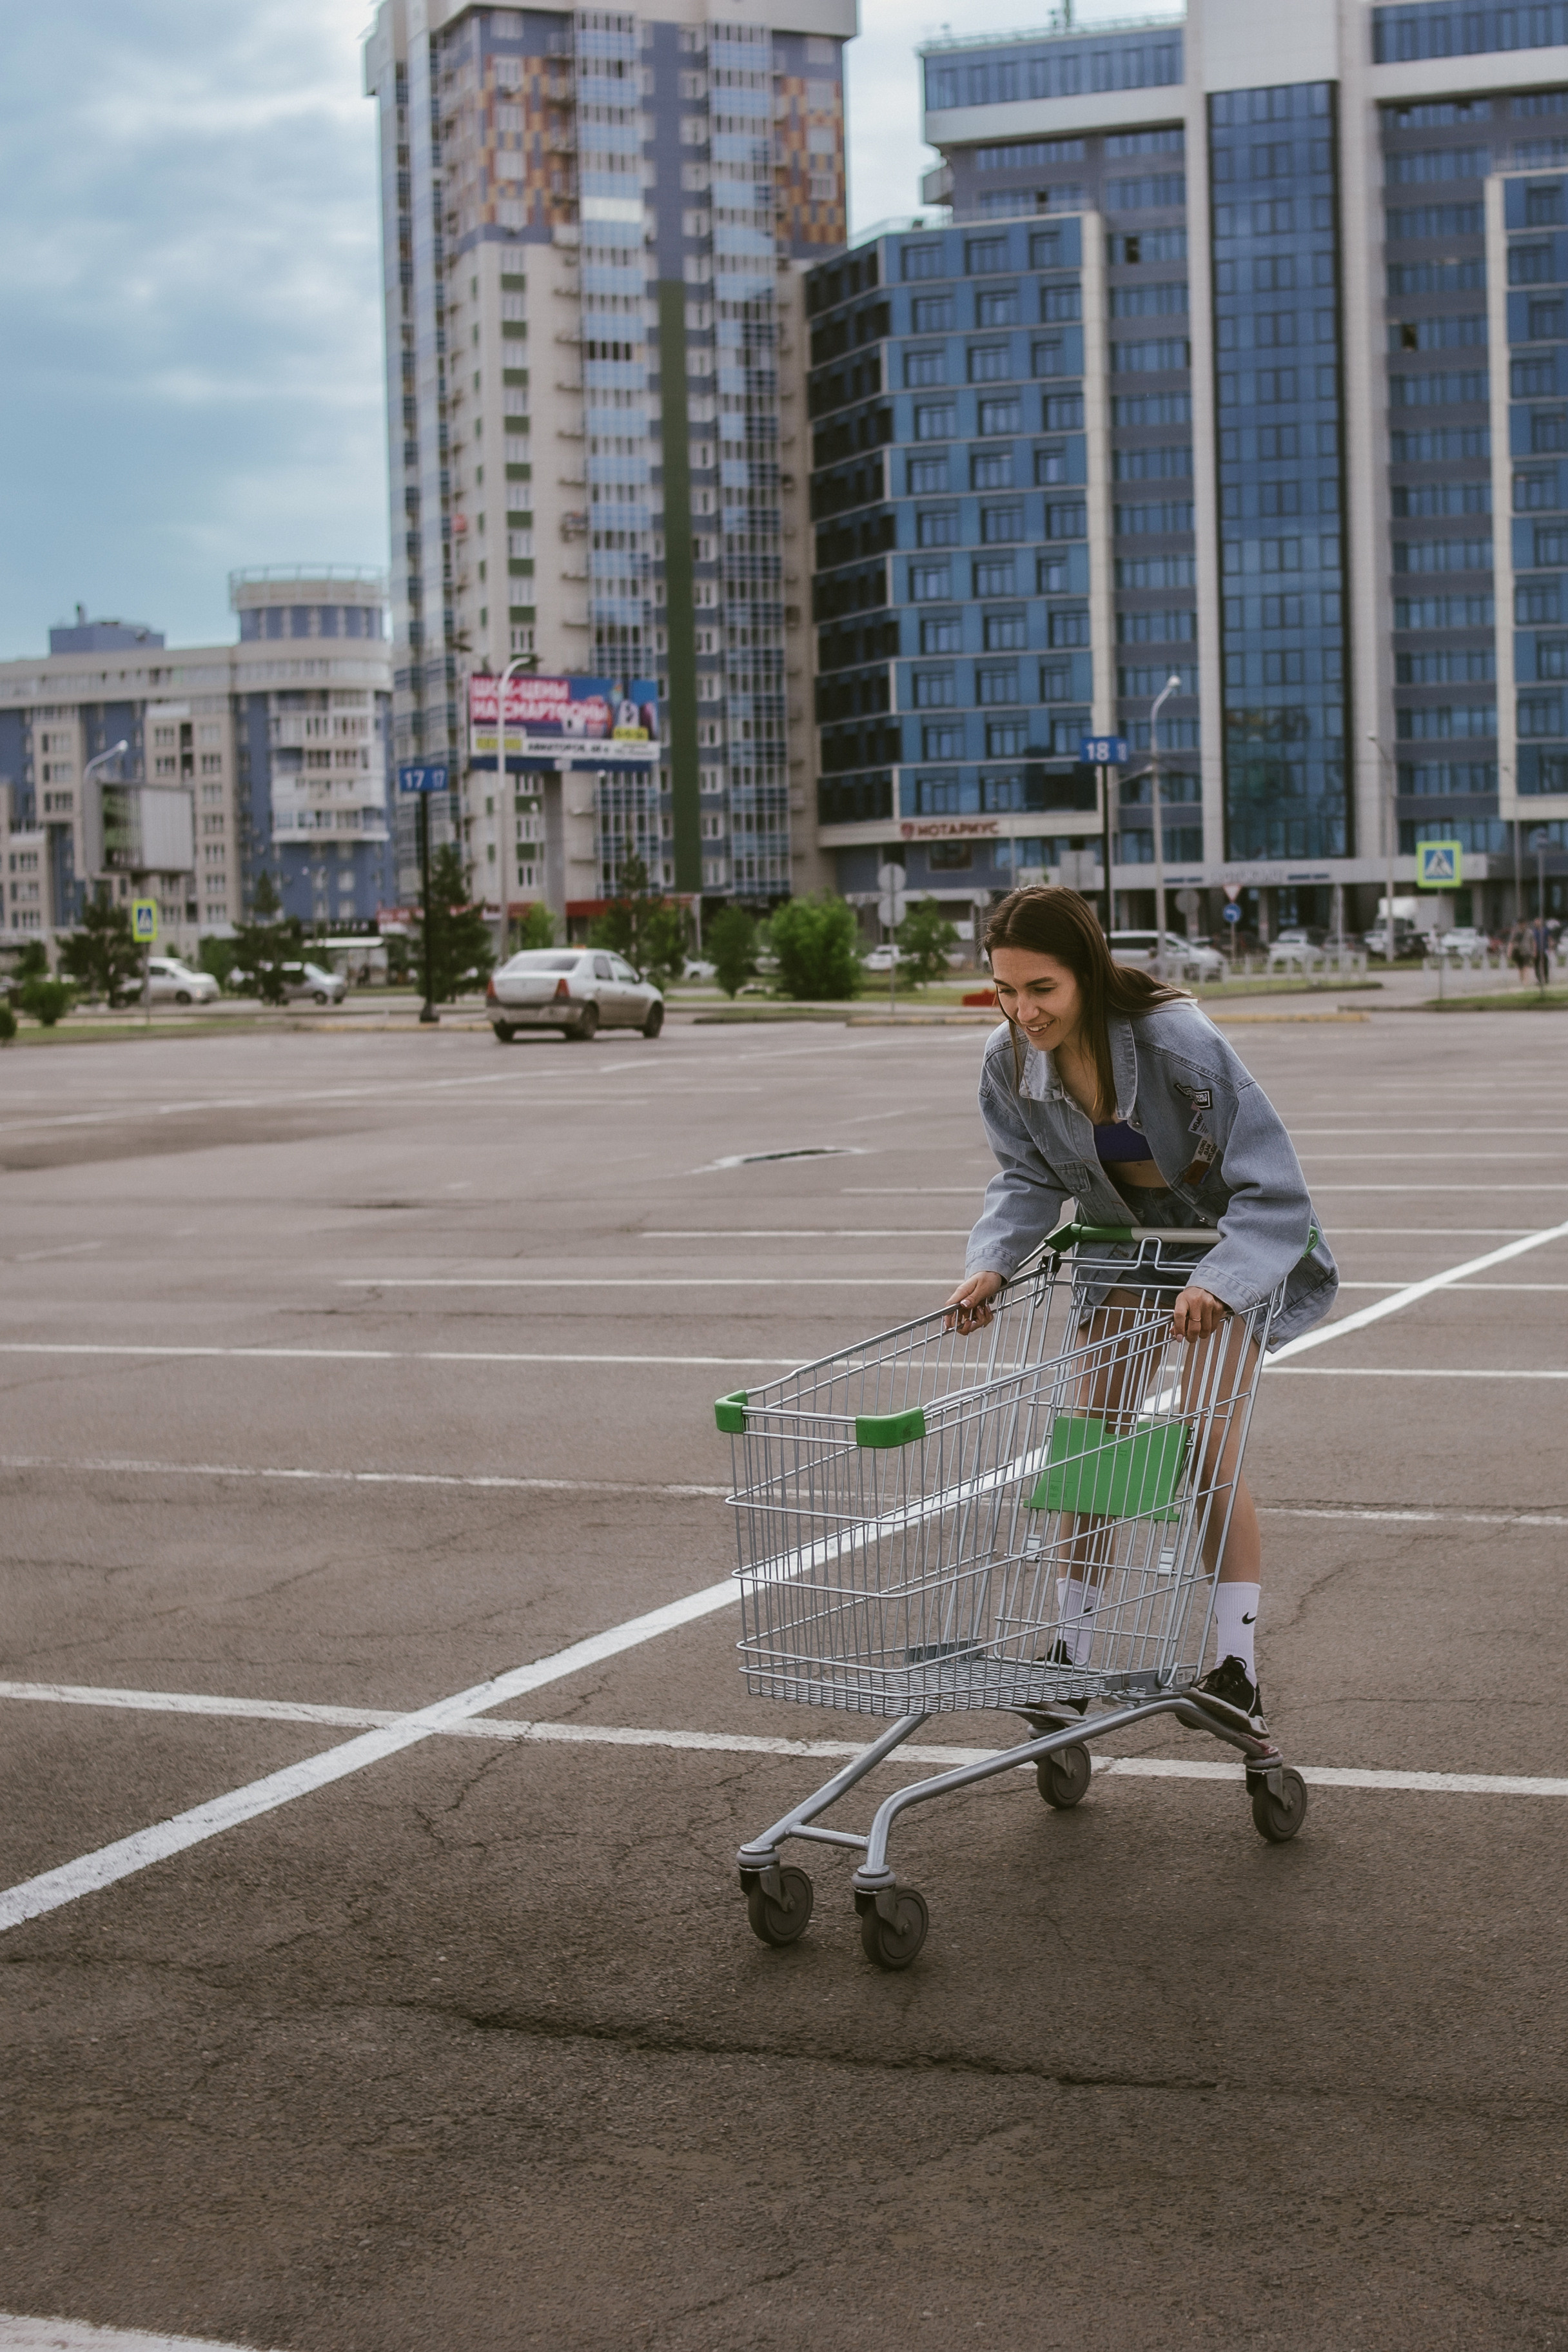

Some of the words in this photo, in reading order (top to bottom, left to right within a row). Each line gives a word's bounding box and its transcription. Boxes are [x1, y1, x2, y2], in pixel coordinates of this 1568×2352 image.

[1088, 741, 1109, 761] 18
[405, 770, 425, 788] 17
[917, 821, 999, 836] НОТАРИУС
